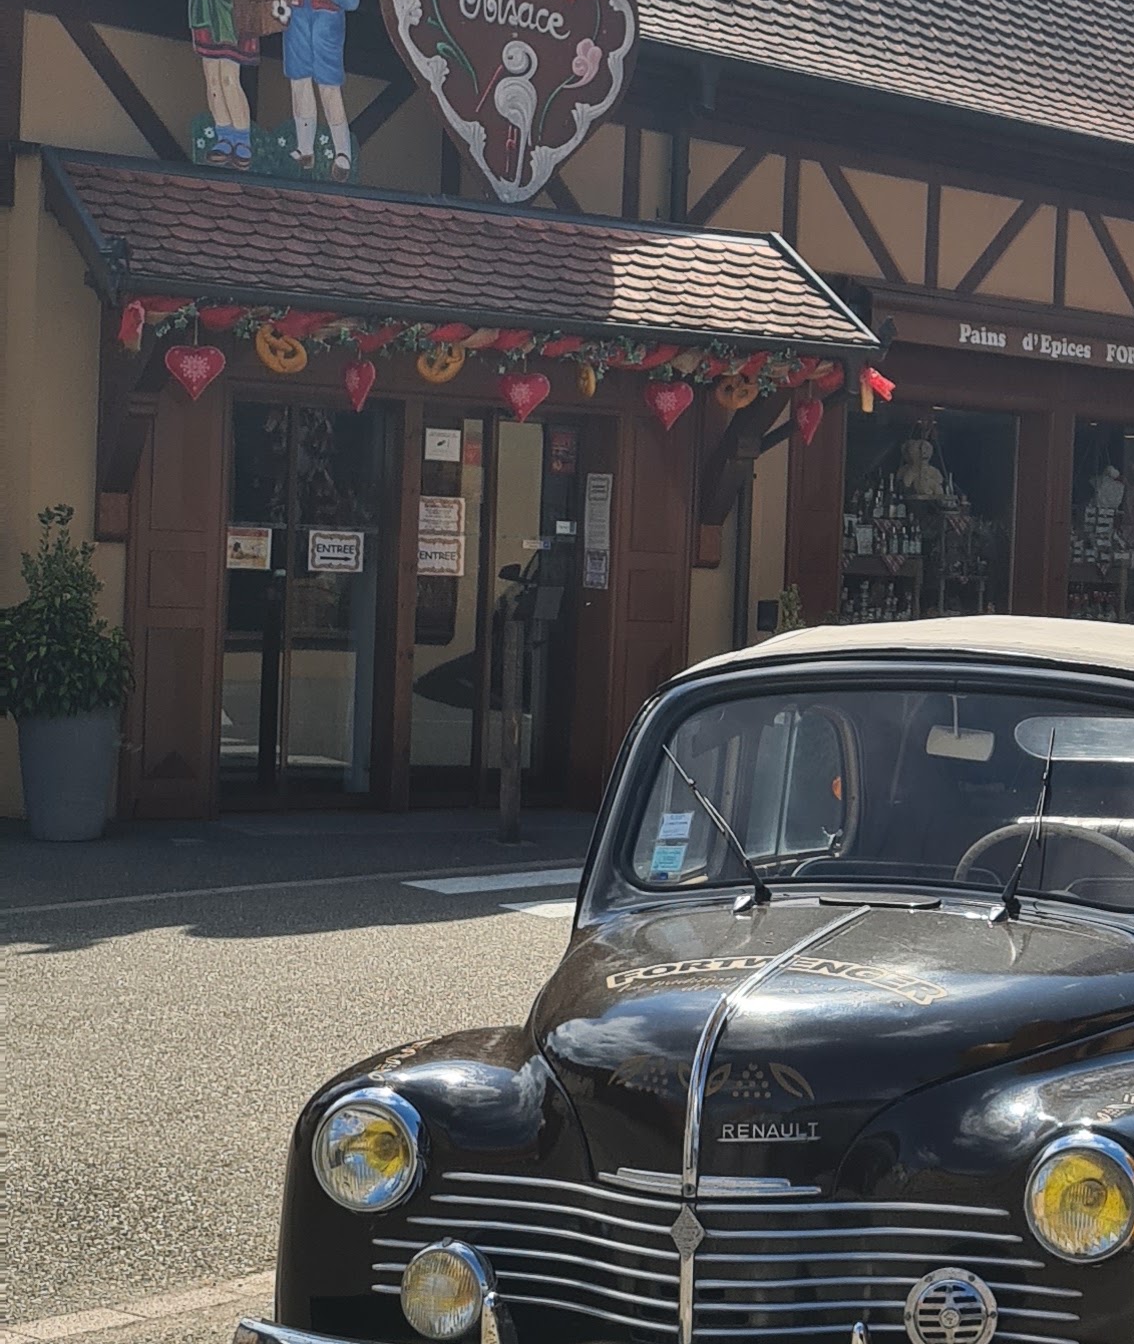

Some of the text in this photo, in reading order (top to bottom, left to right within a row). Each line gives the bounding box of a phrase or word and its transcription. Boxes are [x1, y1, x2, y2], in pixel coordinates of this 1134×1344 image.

[958, 323, 1007, 348] Pains
[1022, 332, 1091, 359] d'Epices
[316, 543, 356, 555] ENTREE
[722, 1122, 819, 1140] RENAULT
